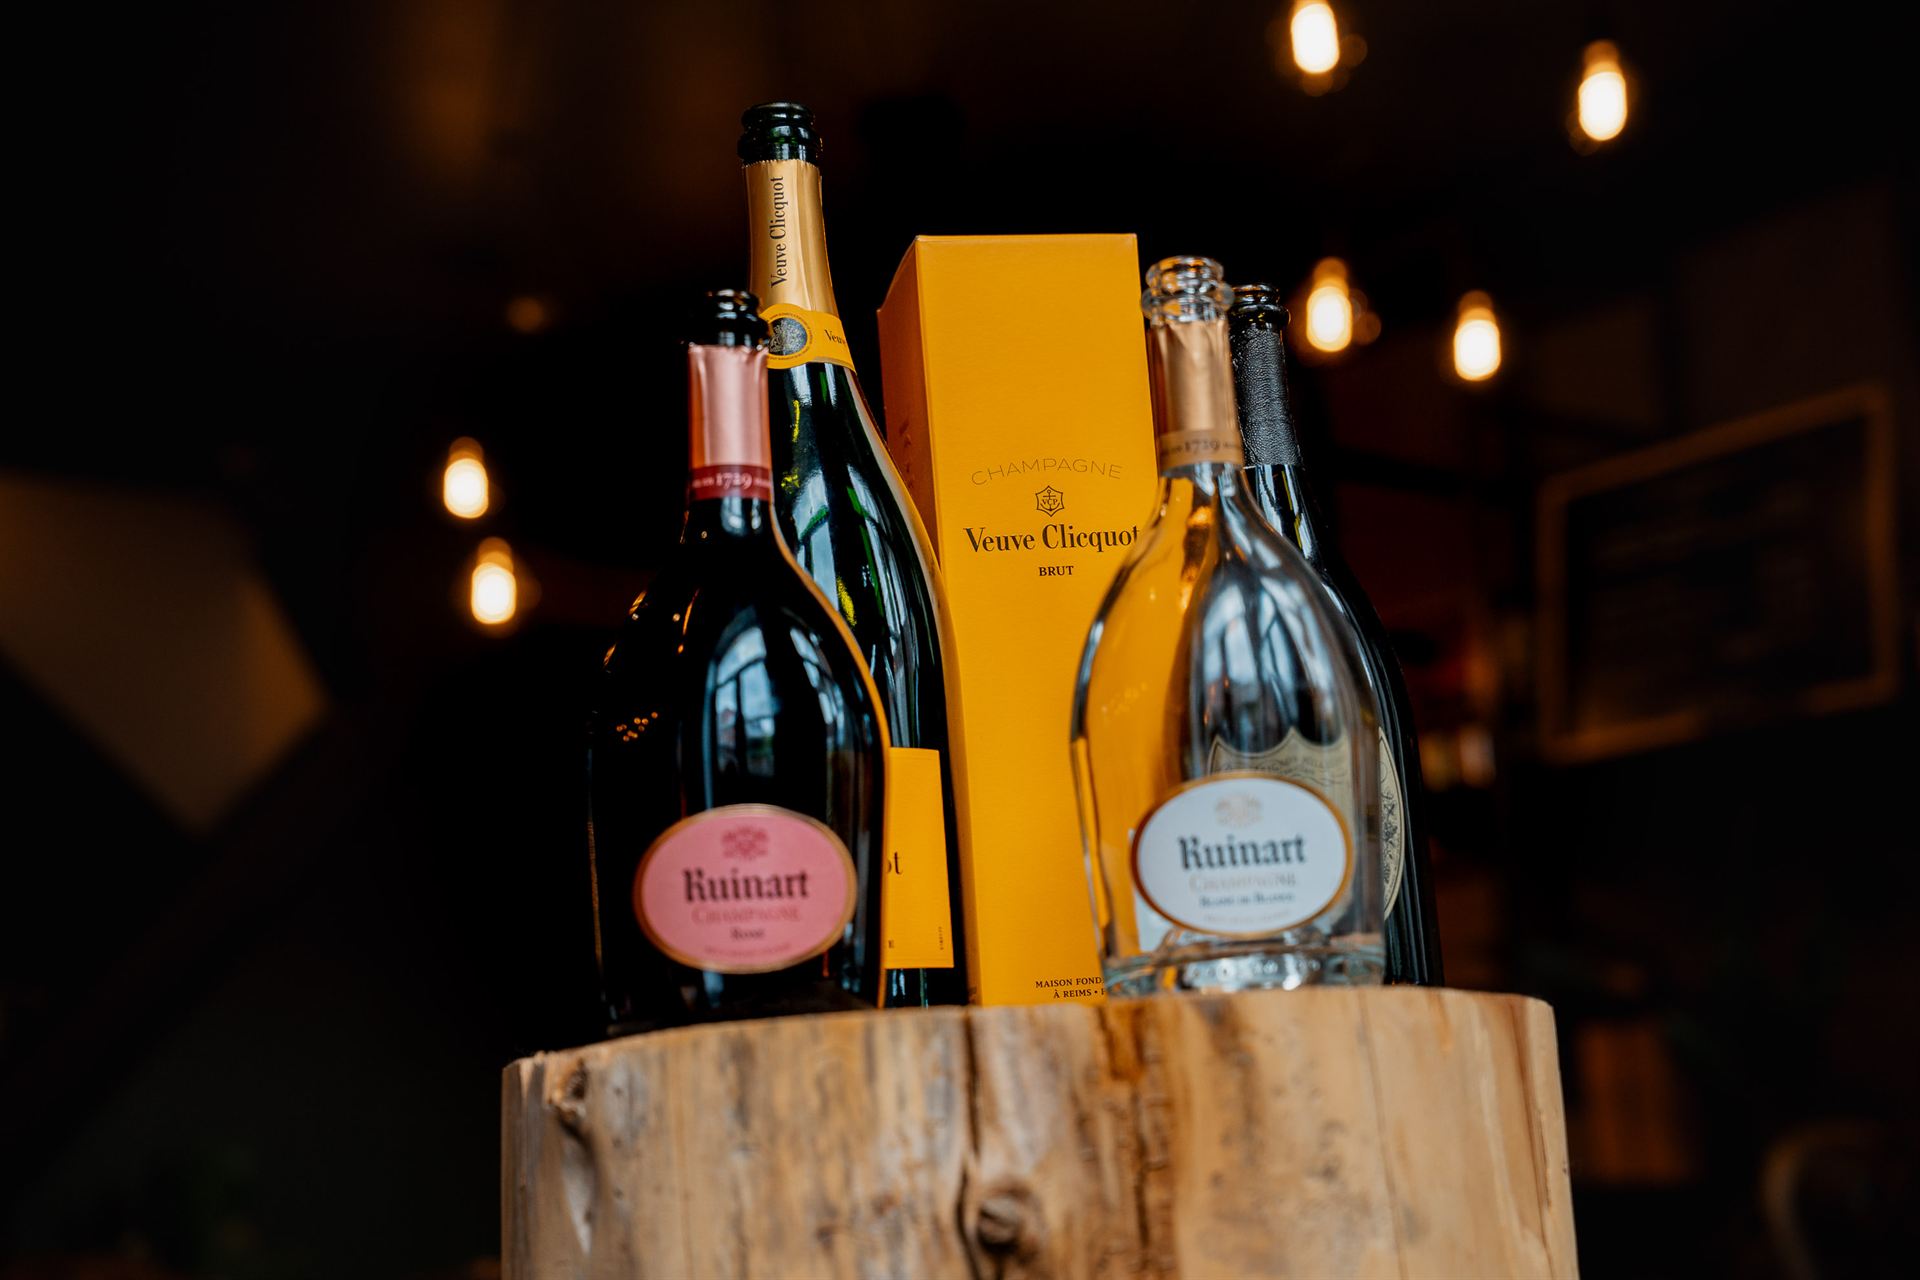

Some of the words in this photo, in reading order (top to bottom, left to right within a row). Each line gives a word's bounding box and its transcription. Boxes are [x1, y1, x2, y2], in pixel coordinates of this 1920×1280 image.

[769, 176, 789, 240] Clicquot
[770, 243, 788, 288] Veuve
[716, 472, 753, 490] 1729
[971, 457, 1124, 486] CHAMPAGNE
[963, 526, 1036, 553] Veuve
[1041, 523, 1140, 553] Clicquot
[1038, 565, 1074, 577] BRUT
[1178, 834, 1306, 870] Ruinart
[682, 867, 808, 902] Ruinart
[1035, 979, 1072, 988] MAISON
[1053, 989, 1060, 998] À
[1063, 989, 1092, 998] REIMS
